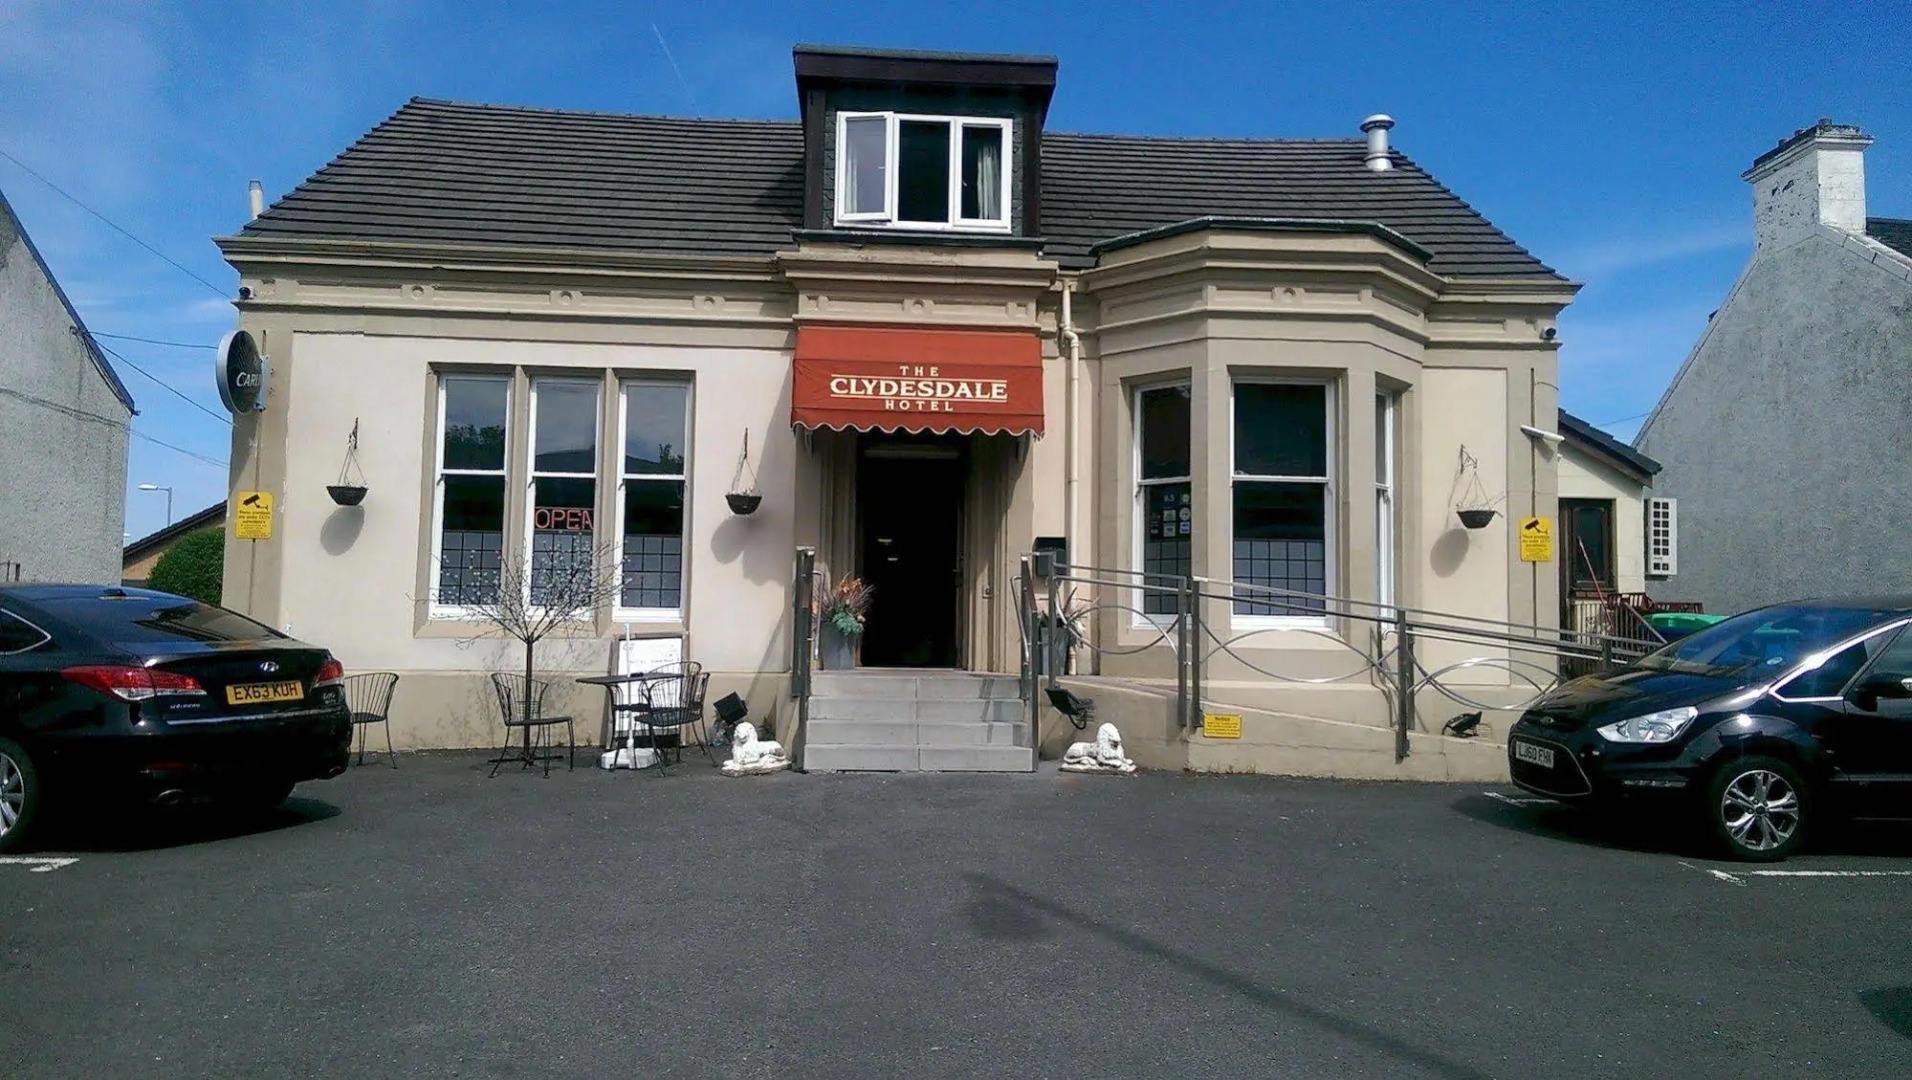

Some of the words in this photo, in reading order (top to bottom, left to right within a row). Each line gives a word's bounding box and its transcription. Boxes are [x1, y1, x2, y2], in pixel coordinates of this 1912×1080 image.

[899, 365, 940, 377] THE
[829, 378, 1008, 399] CLYDESDALE
[885, 399, 954, 412] HOTEL
[234, 685, 270, 701] EX63
[272, 683, 298, 698] KUH
